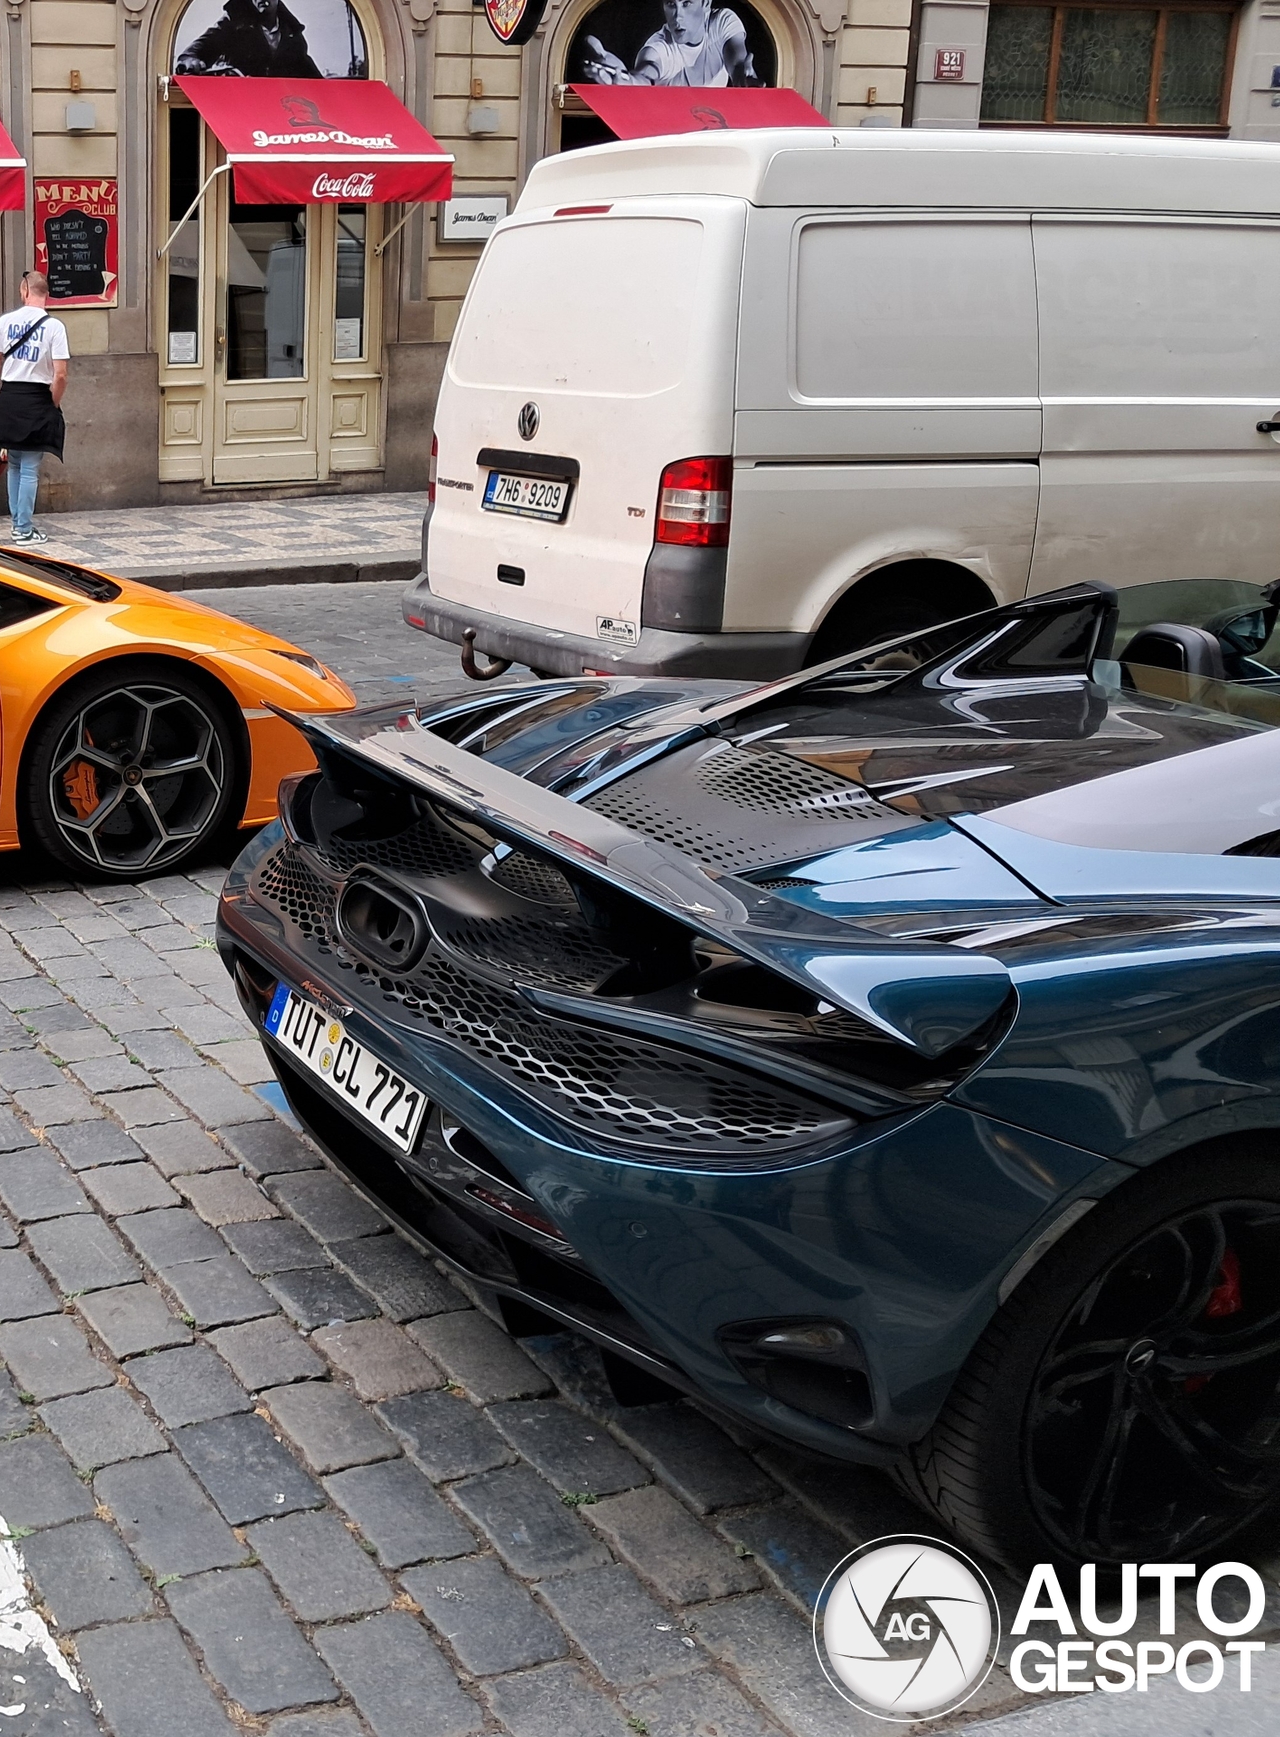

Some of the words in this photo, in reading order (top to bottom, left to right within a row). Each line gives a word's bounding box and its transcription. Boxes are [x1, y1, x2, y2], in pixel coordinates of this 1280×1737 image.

[943, 52, 960, 65] 921
[252, 130, 329, 147] James
[329, 130, 393, 147] Dean
[35, 180, 117, 203] MENU
[311, 172, 377, 198] Coca-Cola
[91, 203, 116, 215] CLUB
[452, 212, 476, 225] James
[476, 212, 497, 222] Dean
[72, 250, 91, 260] PARTY
[12, 344, 40, 362] ORLD
[495, 477, 522, 501] 7H6
[527, 483, 562, 509] 9209
[627, 506, 646, 518] TDI
[599, 619, 614, 630] AP
[283, 991, 327, 1059] TUT
[332, 1036, 361, 1099] CL
[365, 1062, 420, 1141] 771
